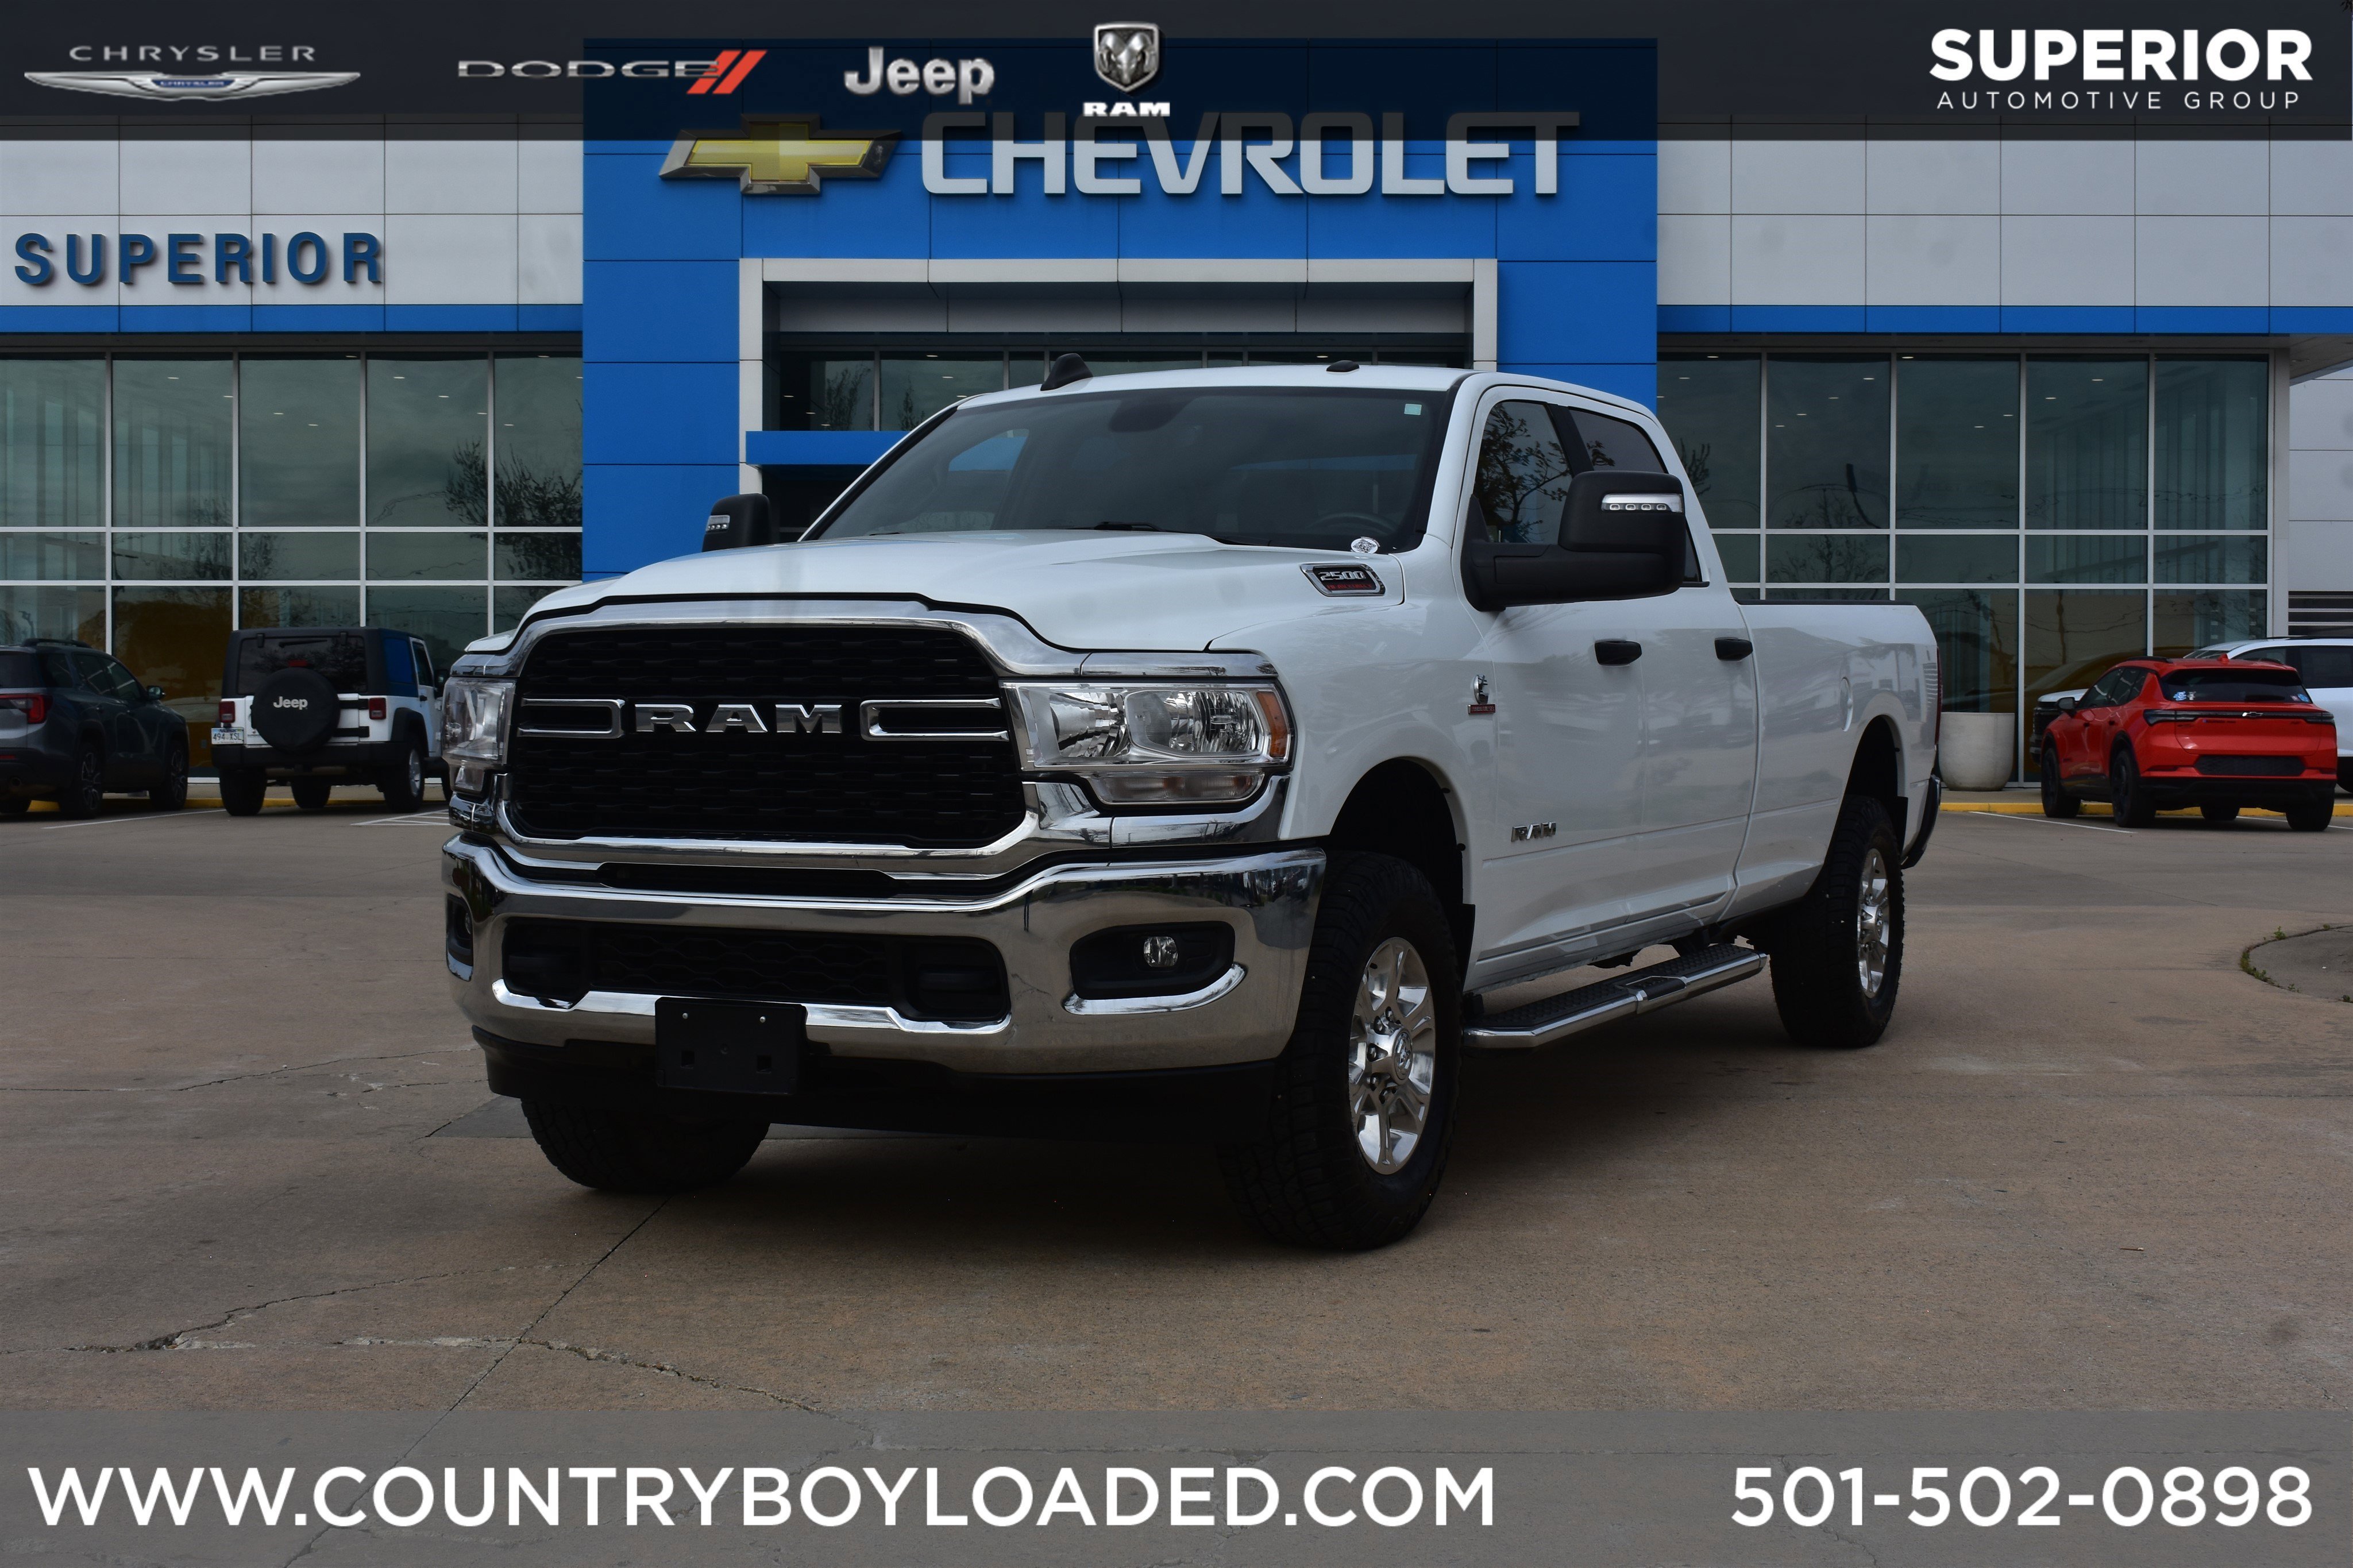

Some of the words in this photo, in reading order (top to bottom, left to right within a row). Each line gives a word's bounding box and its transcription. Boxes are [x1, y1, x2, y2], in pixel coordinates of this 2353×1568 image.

[921, 111, 1581, 196] CHEVROLET
[14, 231, 384, 287] SUPERIOR
[1320, 570, 1366, 581] 2500
[273, 696, 308, 710] Jeep
[634, 703, 843, 734] RAM
[1510, 821, 1557, 843] RAM
